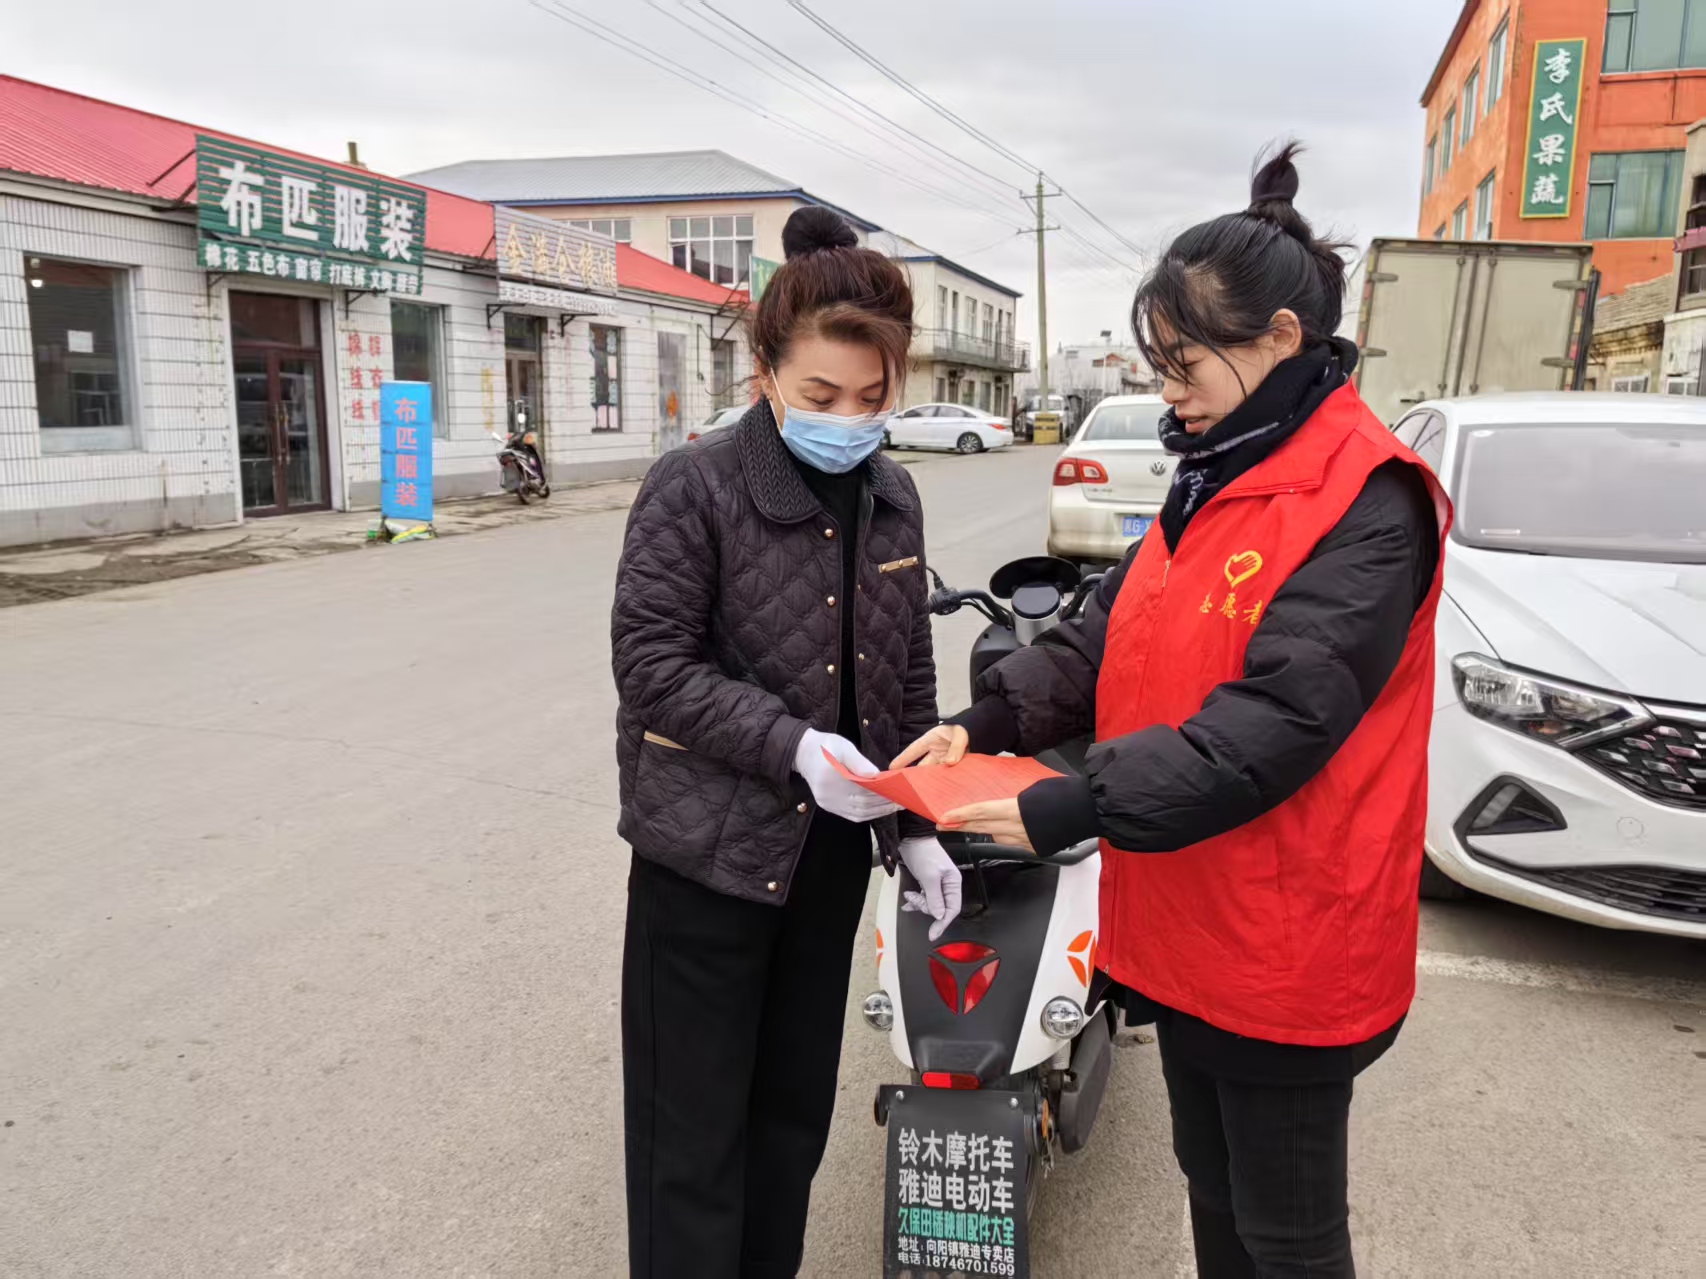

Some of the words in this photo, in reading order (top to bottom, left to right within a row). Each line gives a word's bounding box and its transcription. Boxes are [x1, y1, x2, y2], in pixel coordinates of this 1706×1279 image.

[1531, 48, 1573, 204] 李氏果蔬
[219, 160, 414, 262] 布匹服装
[247, 250, 289, 278] 五色布
[395, 397, 418, 507] 布匹服装
[898, 1128, 1014, 1174] 铃木摩托车
[898, 1168, 1014, 1214] 雅迪电动车
[898, 1207, 1015, 1246] 久保田插秧机配件大全
